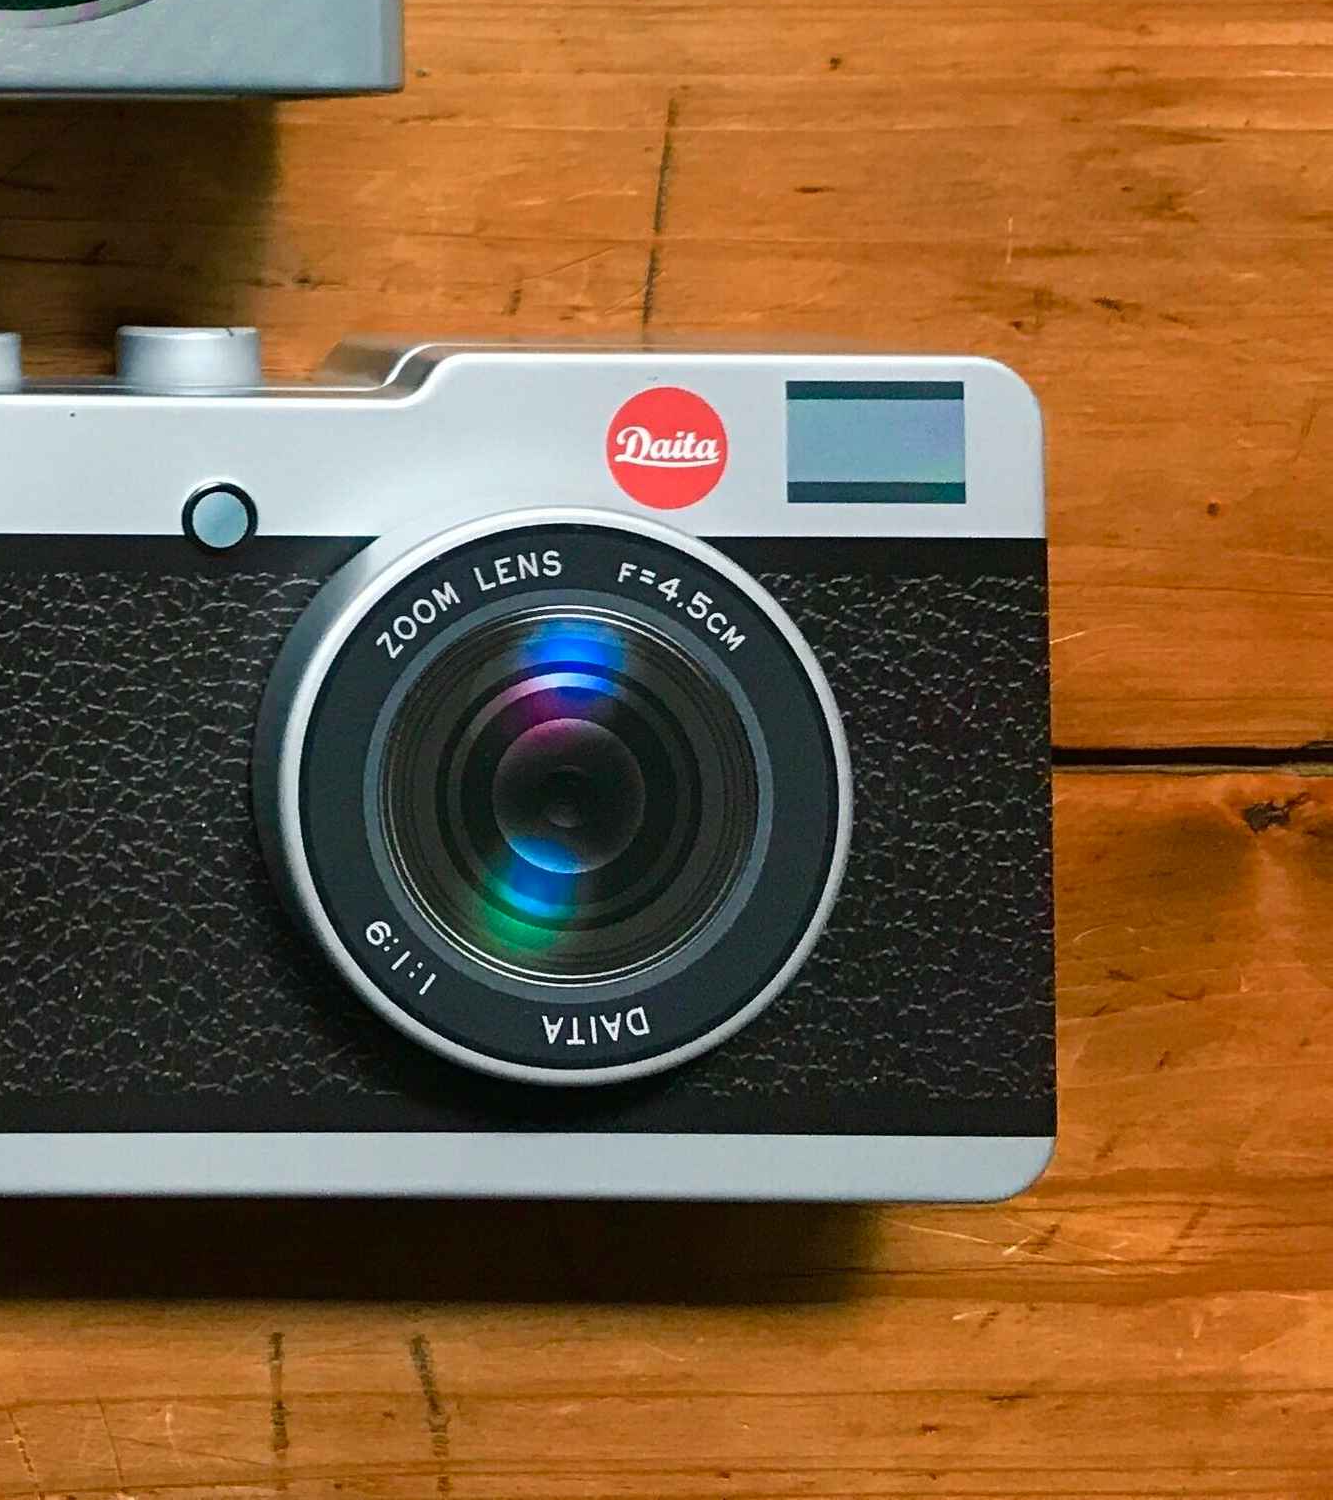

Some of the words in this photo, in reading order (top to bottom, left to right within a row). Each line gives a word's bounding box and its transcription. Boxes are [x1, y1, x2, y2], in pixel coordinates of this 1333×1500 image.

[614, 425, 721, 467] Daita
[376, 581, 461, 659] ZOOM
[473, 550, 564, 592] LENS
[616, 562, 747, 653] F=4.5CM
[541, 1006, 651, 1046] DAITA
